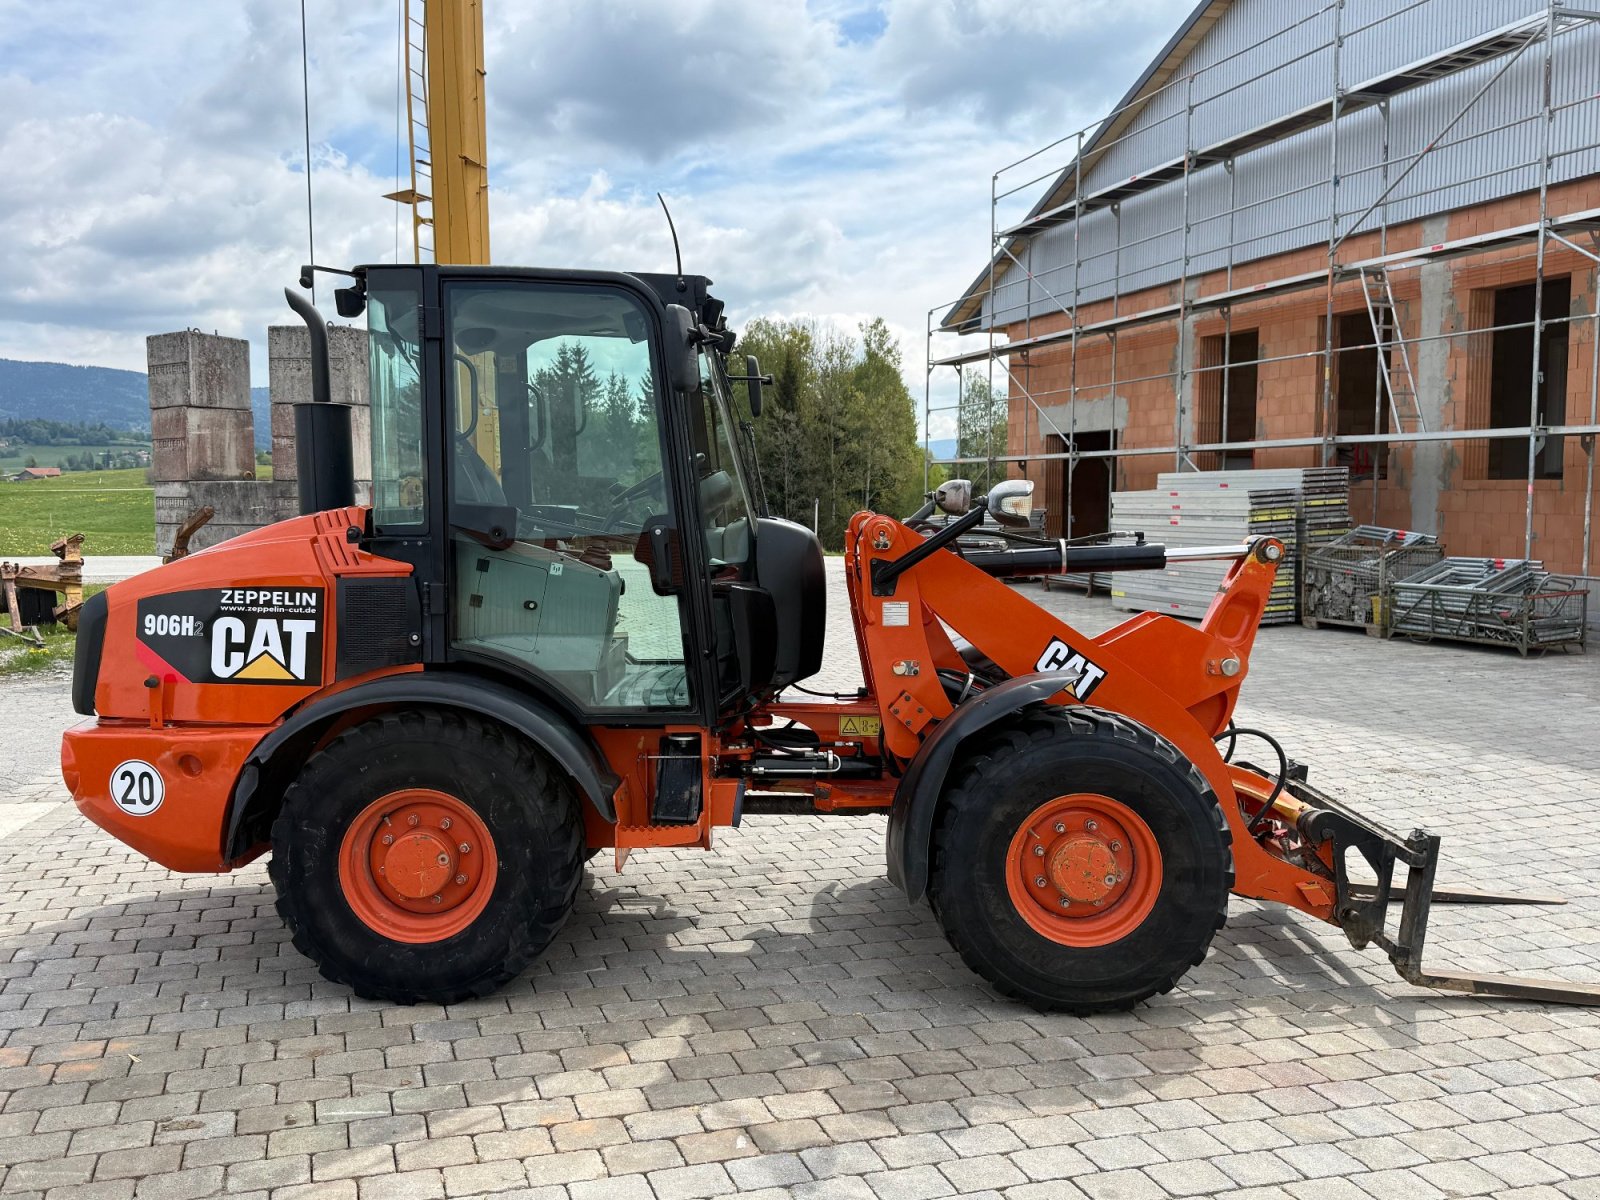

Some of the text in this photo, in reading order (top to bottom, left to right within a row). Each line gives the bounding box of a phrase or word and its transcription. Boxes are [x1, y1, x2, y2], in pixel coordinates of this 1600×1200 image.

[220, 589, 317, 606] ZEPPELIN
[211, 616, 316, 680] CAT
[1036, 640, 1105, 699] CAT
[120, 770, 154, 806] 20
